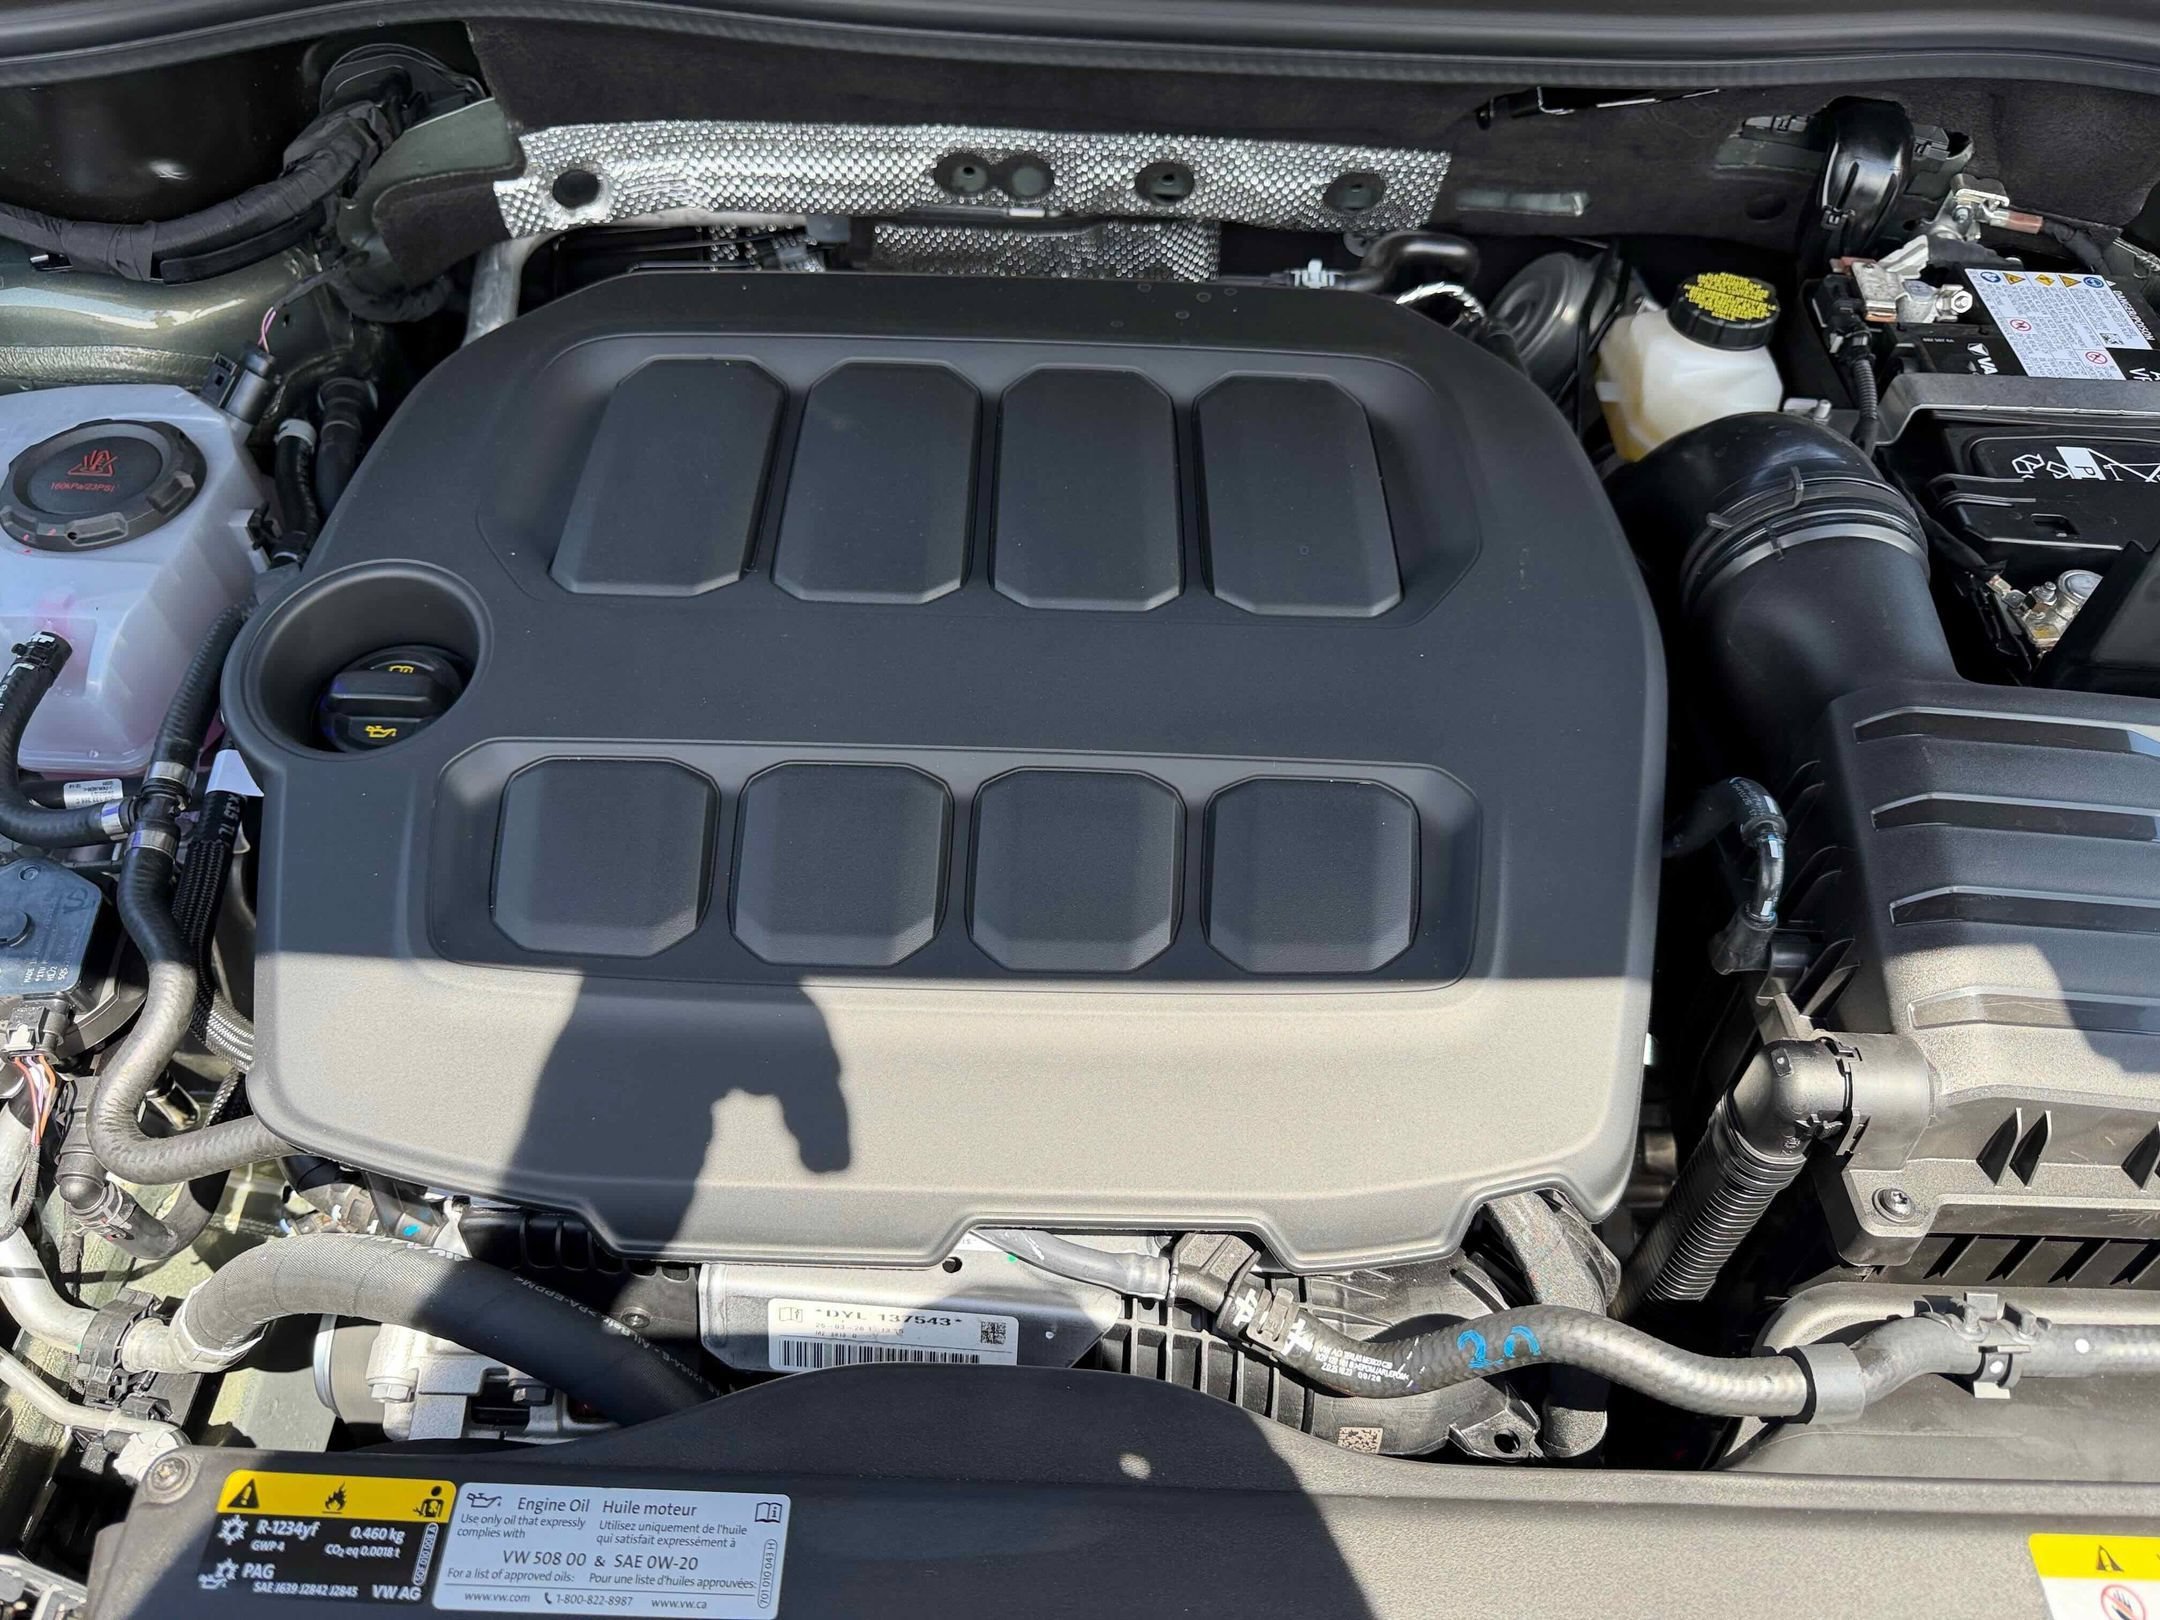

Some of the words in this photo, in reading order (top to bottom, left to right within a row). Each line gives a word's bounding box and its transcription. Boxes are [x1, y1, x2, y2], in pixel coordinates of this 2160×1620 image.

[2113, 290, 2155, 341] DANGER/POISON
[518, 1497, 566, 1514] Engine
[569, 1498, 591, 1512] Oil
[602, 1500, 641, 1515] Huile
[643, 1503, 697, 1516] moteur
[460, 1513, 479, 1524] Use
[481, 1514, 502, 1527] only
[504, 1515, 516, 1525] oil
[518, 1516, 538, 1527] that
[540, 1517, 587, 1530] expressly
[599, 1519, 637, 1531] Utilisez
[638, 1521, 700, 1534] uniquement
[702, 1523, 715, 1534] de
[716, 1524, 748, 1536] l'huile
[256, 1519, 321, 1541] R-1234yf
[350, 1526, 387, 1541] 0.460
[388, 1528, 406, 1545] kg
[457, 1527, 501, 1538] complies
[503, 1528, 526, 1539] with
[250, 1540, 276, 1551] GWP
[277, 1541, 285, 1552] 4
[345, 1547, 359, 1559] eq
[360, 1545, 394, 1558] 0.0018
[394, 1548, 401, 1558] t
[596, 1533, 613, 1545] qui
[615, 1534, 655, 1545] satisfait
[657, 1536, 728, 1550] expressément
[729, 1537, 736, 1548] à
[767, 1542, 776, 1550] H
[503, 1550, 531, 1564] VW
[533, 1551, 562, 1566] 508
[566, 1552, 587, 1567] 00
[594, 1555, 607, 1568] &
[614, 1554, 643, 1569] SAE
[647, 1556, 699, 1571] 0W-20
[765, 1552, 775, 1570] 043
[242, 1562, 276, 1580] PAG
[447, 1567, 463, 1578] For
[465, 1570, 472, 1578] a
[474, 1568, 489, 1579] list
[491, 1569, 503, 1580] of
[504, 1569, 552, 1583] approved
[554, 1571, 575, 1582] oils:
[589, 1573, 612, 1584] Pour
[613, 1575, 632, 1585] une
[635, 1575, 655, 1585] liste
[657, 1575, 695, 1587] d'huiles
[696, 1577, 757, 1591] approuvées:
[762, 1570, 772, 1588] 010
[253, 1580, 274, 1593] SAE
[274, 1581, 298, 1594] J639
[299, 1583, 329, 1596] J2842
[329, 1584, 359, 1598] J2845
[372, 1584, 398, 1599] VW
[398, 1586, 422, 1601] AG
[759, 1589, 770, 1605] 701
[464, 1592, 531, 1603] www.vw.com
[556, 1593, 633, 1608] 1-800-822-8987
[651, 1599, 708, 1610] www.vw.ca
